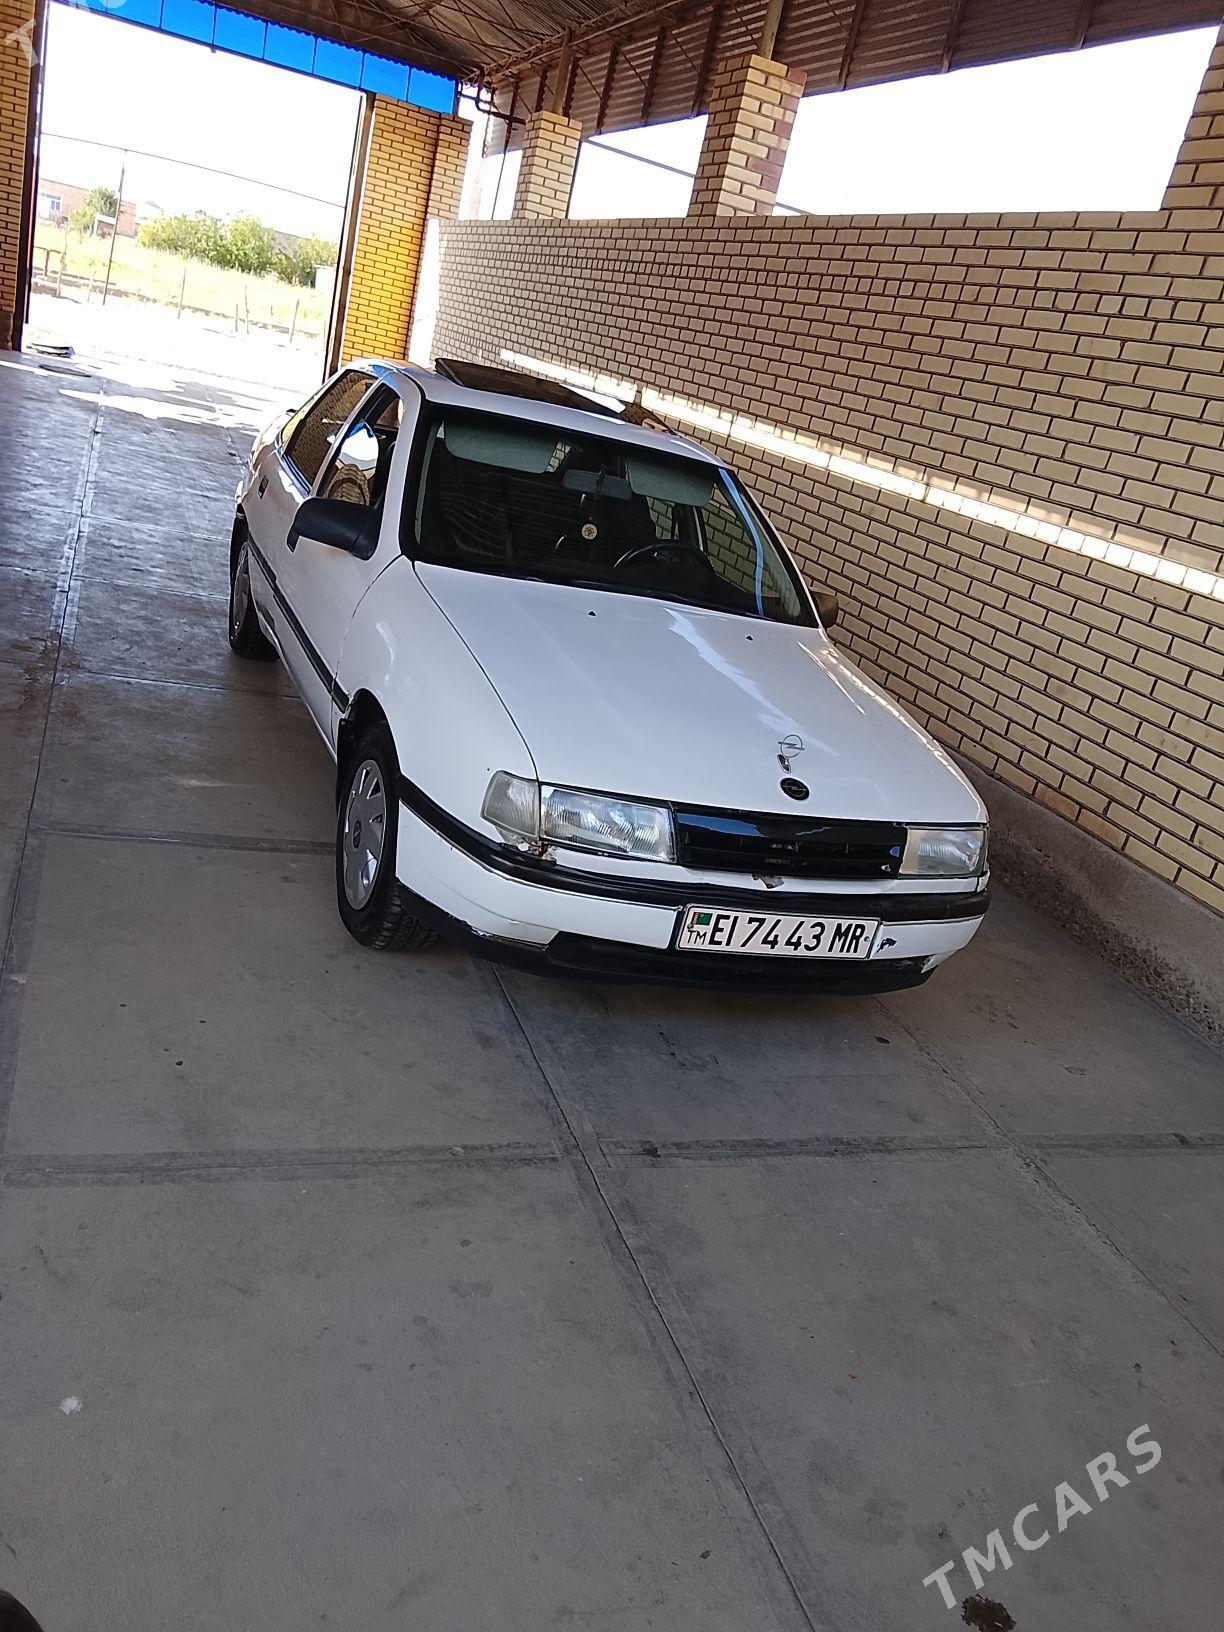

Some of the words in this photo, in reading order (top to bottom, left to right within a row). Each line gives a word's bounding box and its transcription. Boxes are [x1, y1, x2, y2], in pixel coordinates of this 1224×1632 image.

[686, 929, 708, 945] TM
[740, 916, 826, 952] 7443
[827, 922, 867, 954] MR
